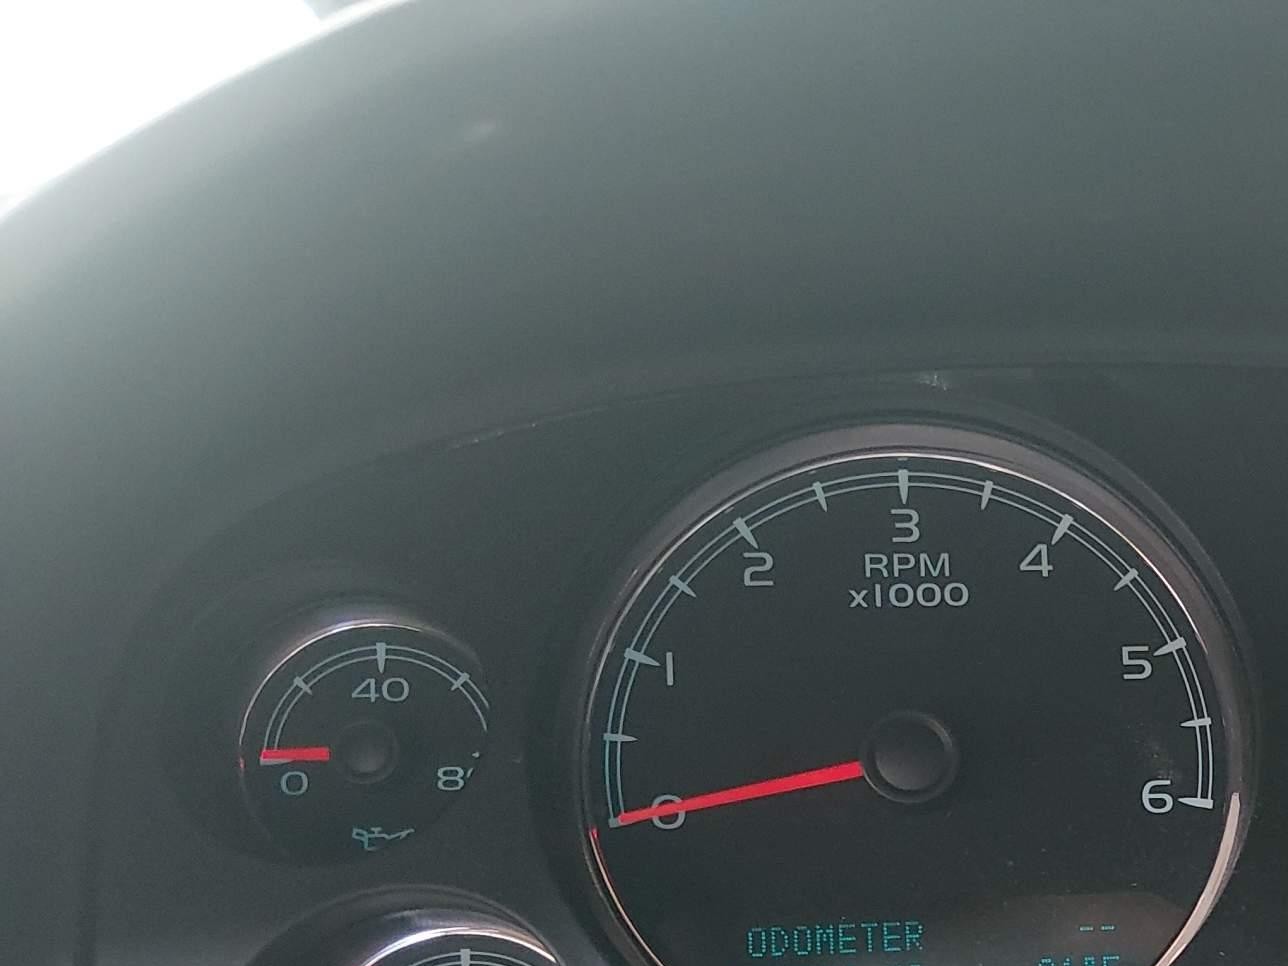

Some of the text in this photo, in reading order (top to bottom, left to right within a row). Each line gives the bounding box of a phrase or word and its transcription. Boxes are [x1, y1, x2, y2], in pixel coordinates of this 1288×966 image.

[890, 508, 920, 543] 3
[743, 552, 775, 587] 2
[864, 552, 950, 578] RPM
[1019, 542, 1054, 578] 4
[848, 581, 969, 609] x1000
[665, 652, 674, 686] 1
[1122, 645, 1154, 680] 5
[351, 677, 410, 703] 40
[280, 771, 309, 795] 0
[1140, 779, 1177, 814] 6
[650, 794, 686, 830] 0
[747, 921, 925, 958] ODOMETER
